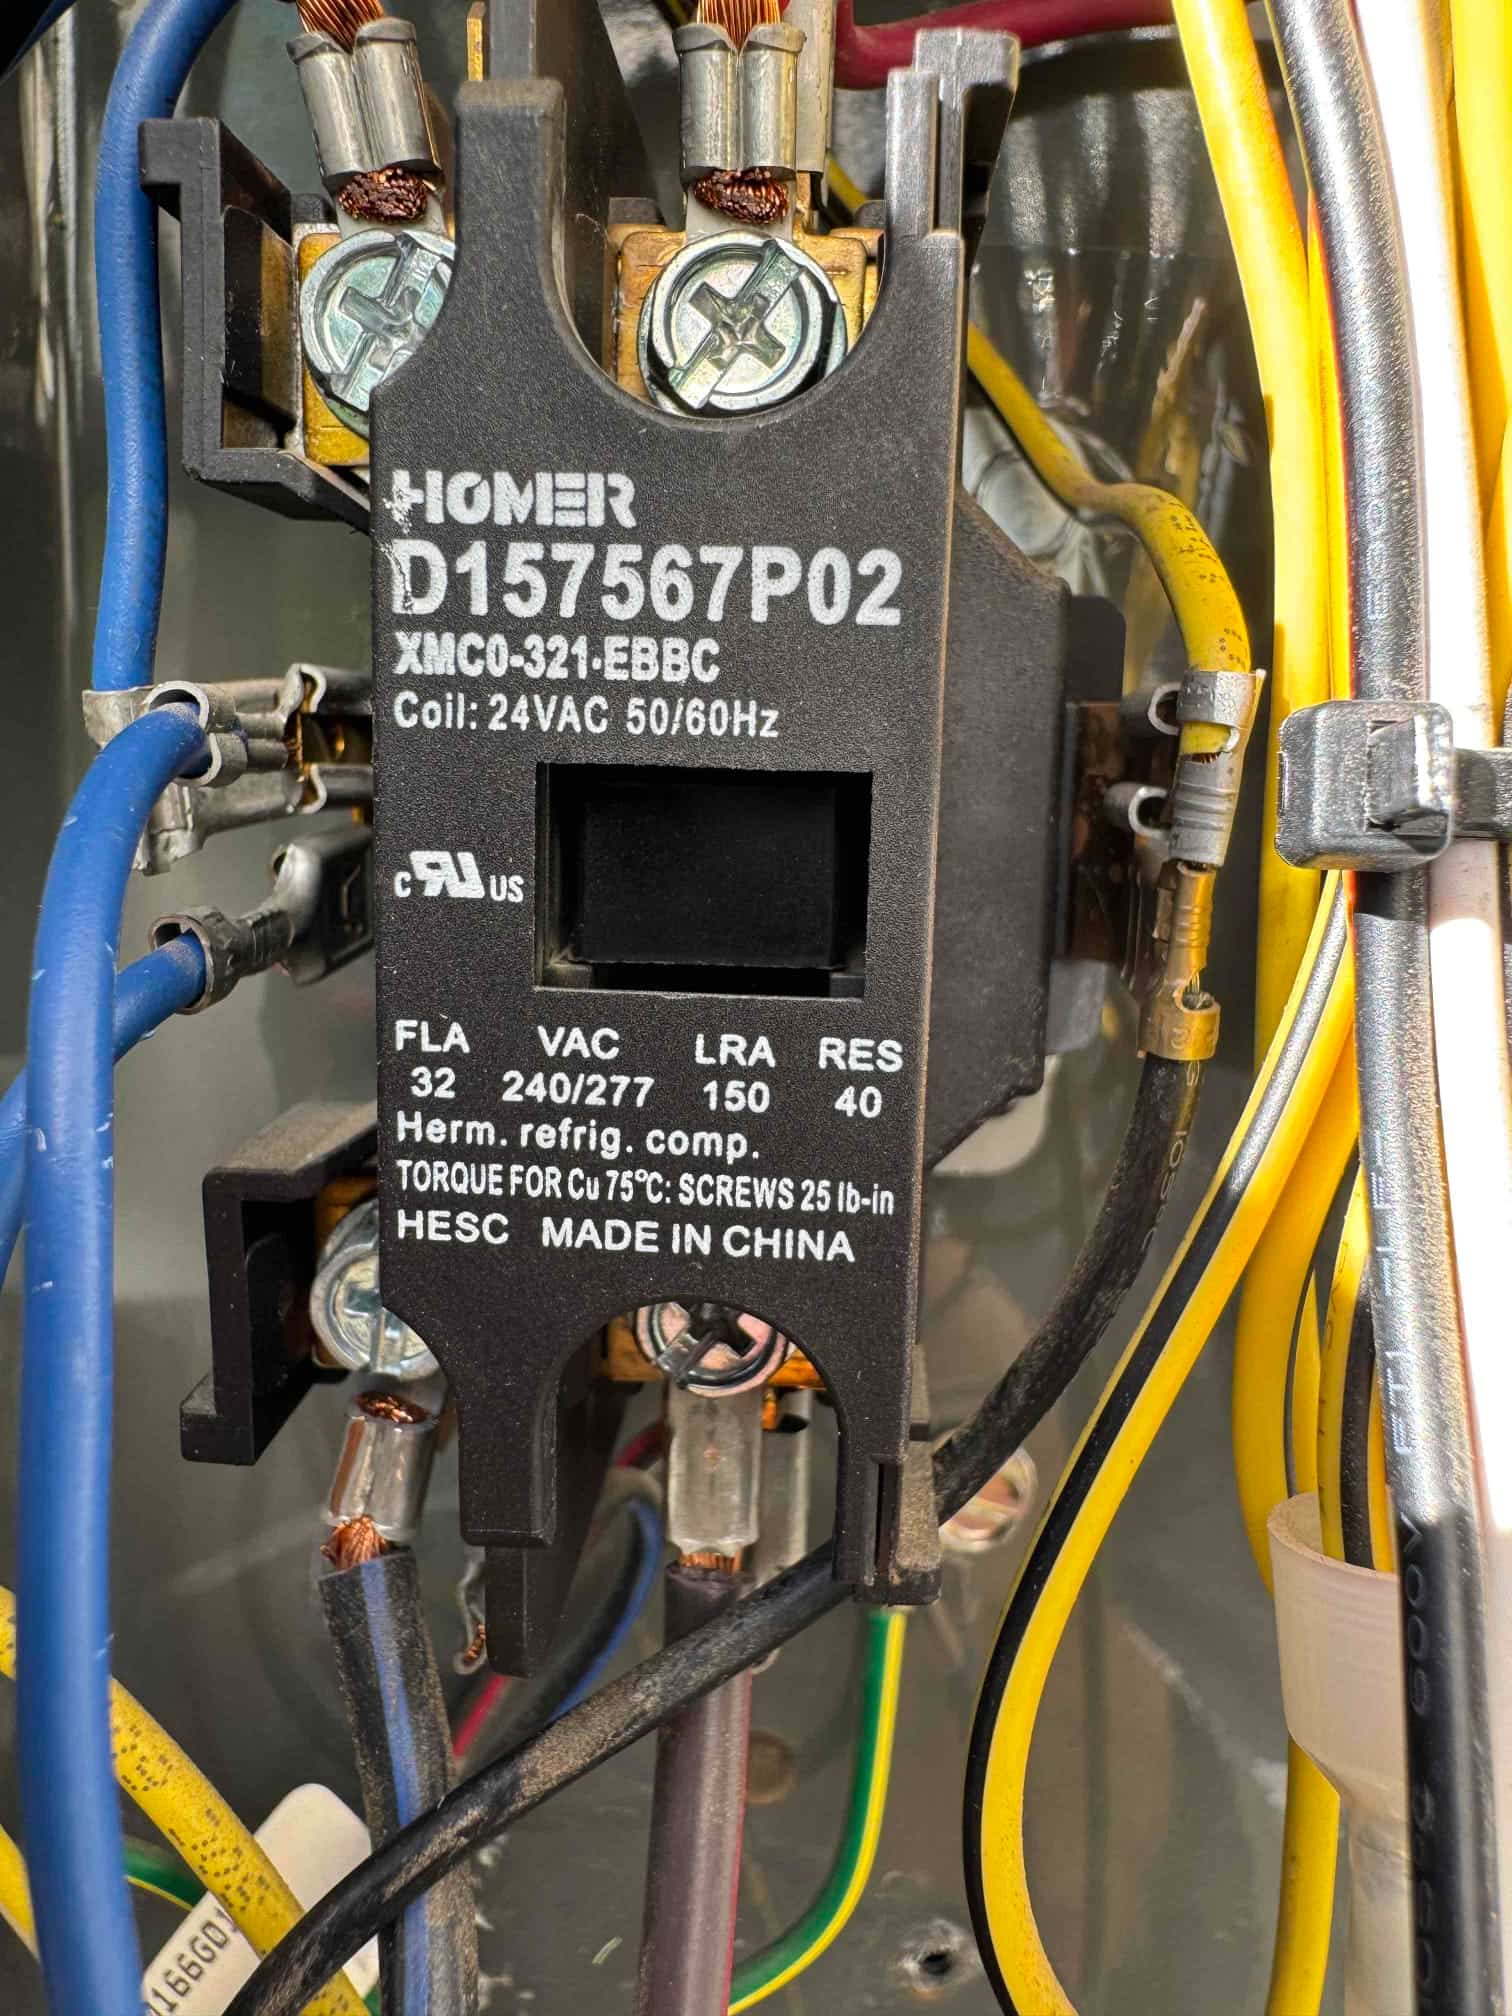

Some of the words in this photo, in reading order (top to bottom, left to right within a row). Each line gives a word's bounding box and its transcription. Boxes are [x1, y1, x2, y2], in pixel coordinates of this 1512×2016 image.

[385, 469, 636, 528] HOMER
[385, 539, 902, 626] D157567P02
[393, 690, 478, 730] Coil:
[488, 693, 608, 734] 24VAC
[625, 696, 779, 738] 50/60Hz
[395, 1020, 470, 1053] FLA
[537, 1026, 619, 1060] VAC
[695, 1034, 776, 1067] LRA
[818, 1037, 903, 1072] RES
[411, 1066, 455, 1098] 32
[502, 1070, 654, 1107] 240/277
[703, 1080, 770, 1113] 150
[835, 1086, 882, 1118] 40
[397, 1111, 507, 1146] Herm.
[521, 1117, 632, 1160] refrig.
[646, 1129, 759, 1165] comp.
[396, 1160, 503, 1195] TORQUE
[510, 1164, 561, 1198] FOR
[568, 1168, 599, 1200] Cu
[679, 1173, 794, 1210] SCREWS
[801, 1179, 831, 1211] 25
[838, 1181, 894, 1215] lb-in
[398, 1209, 508, 1244] HESC
[542, 1217, 659, 1252] MADE
[672, 1224, 711, 1255] IN
[723, 1225, 855, 1262] CHINA
